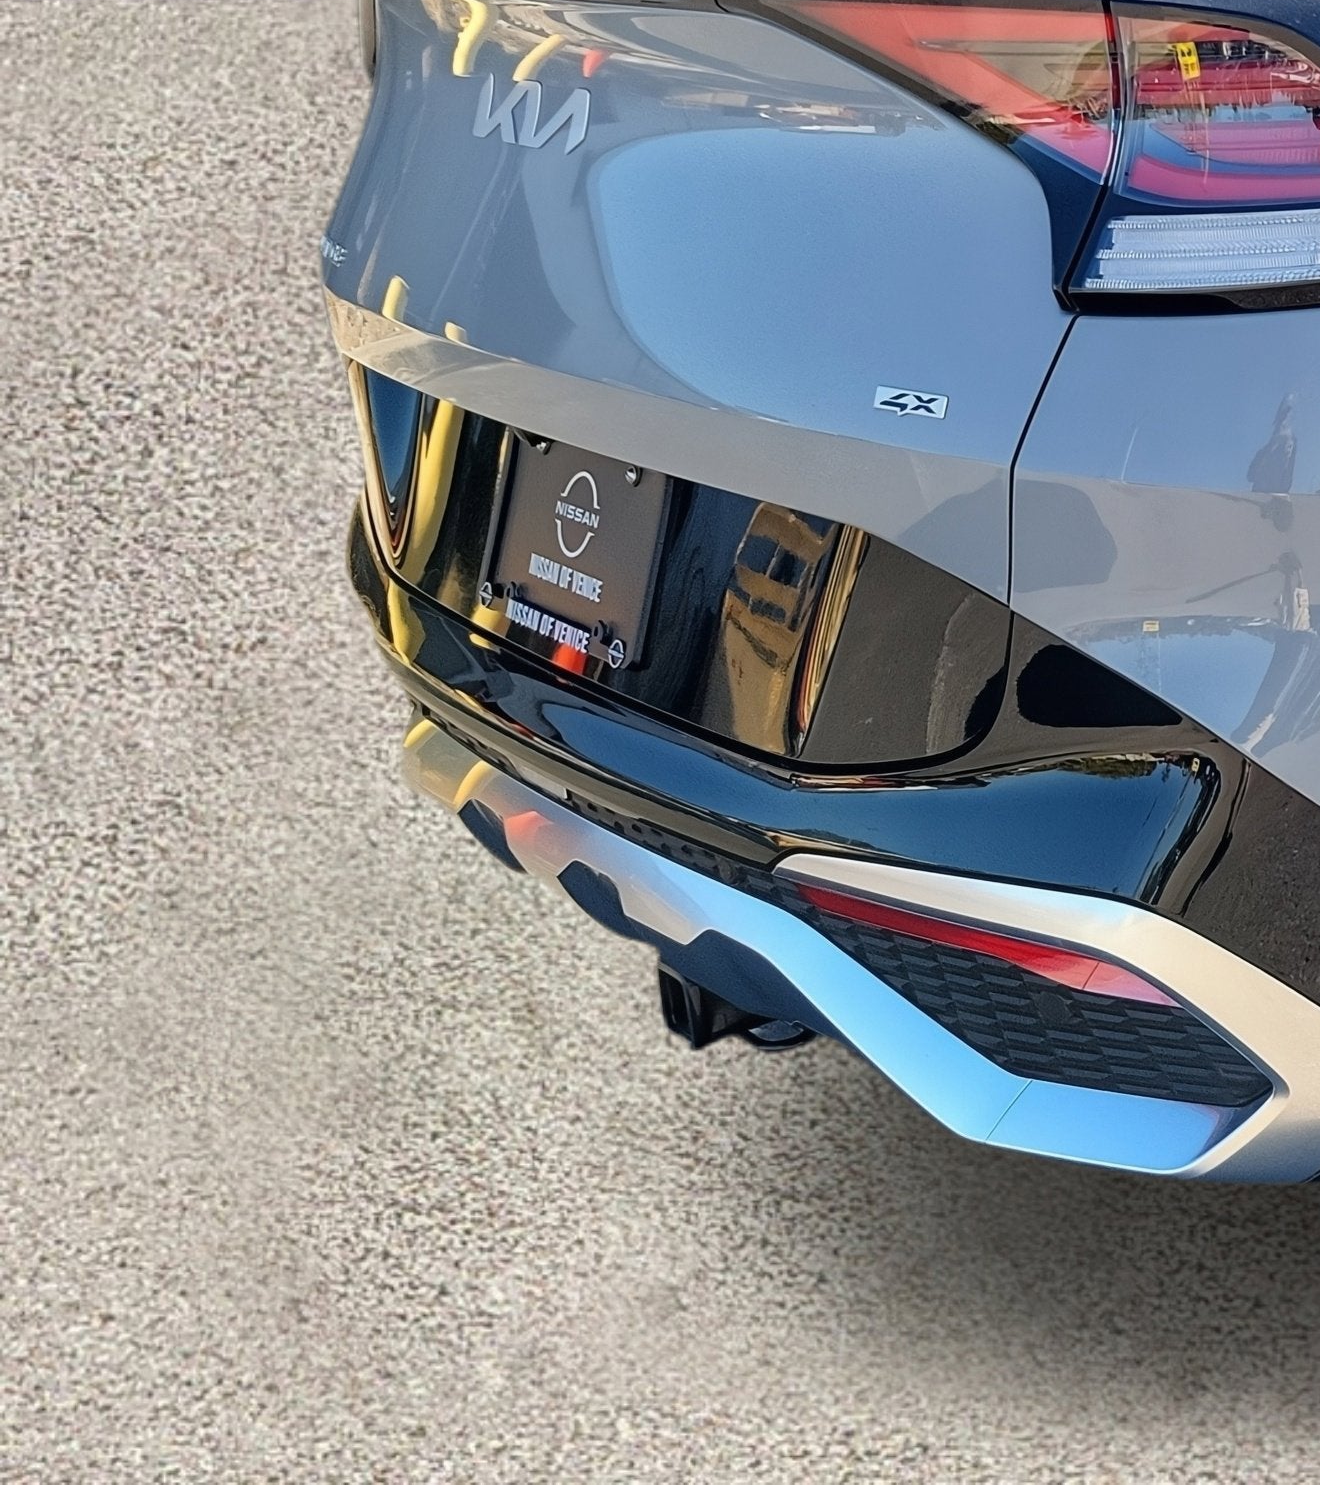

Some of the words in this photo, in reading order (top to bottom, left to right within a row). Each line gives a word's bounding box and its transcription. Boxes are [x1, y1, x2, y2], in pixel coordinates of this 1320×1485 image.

[473, 72, 592, 155] KIA
[555, 501, 600, 529] NISSAN
[529, 552, 561, 585] NISSAN
[559, 565, 573, 590] OF
[571, 570, 604, 603] VENICE
[505, 598, 541, 632] NISSAN
[539, 613, 555, 637] OF
[553, 619, 590, 654] VENICE
